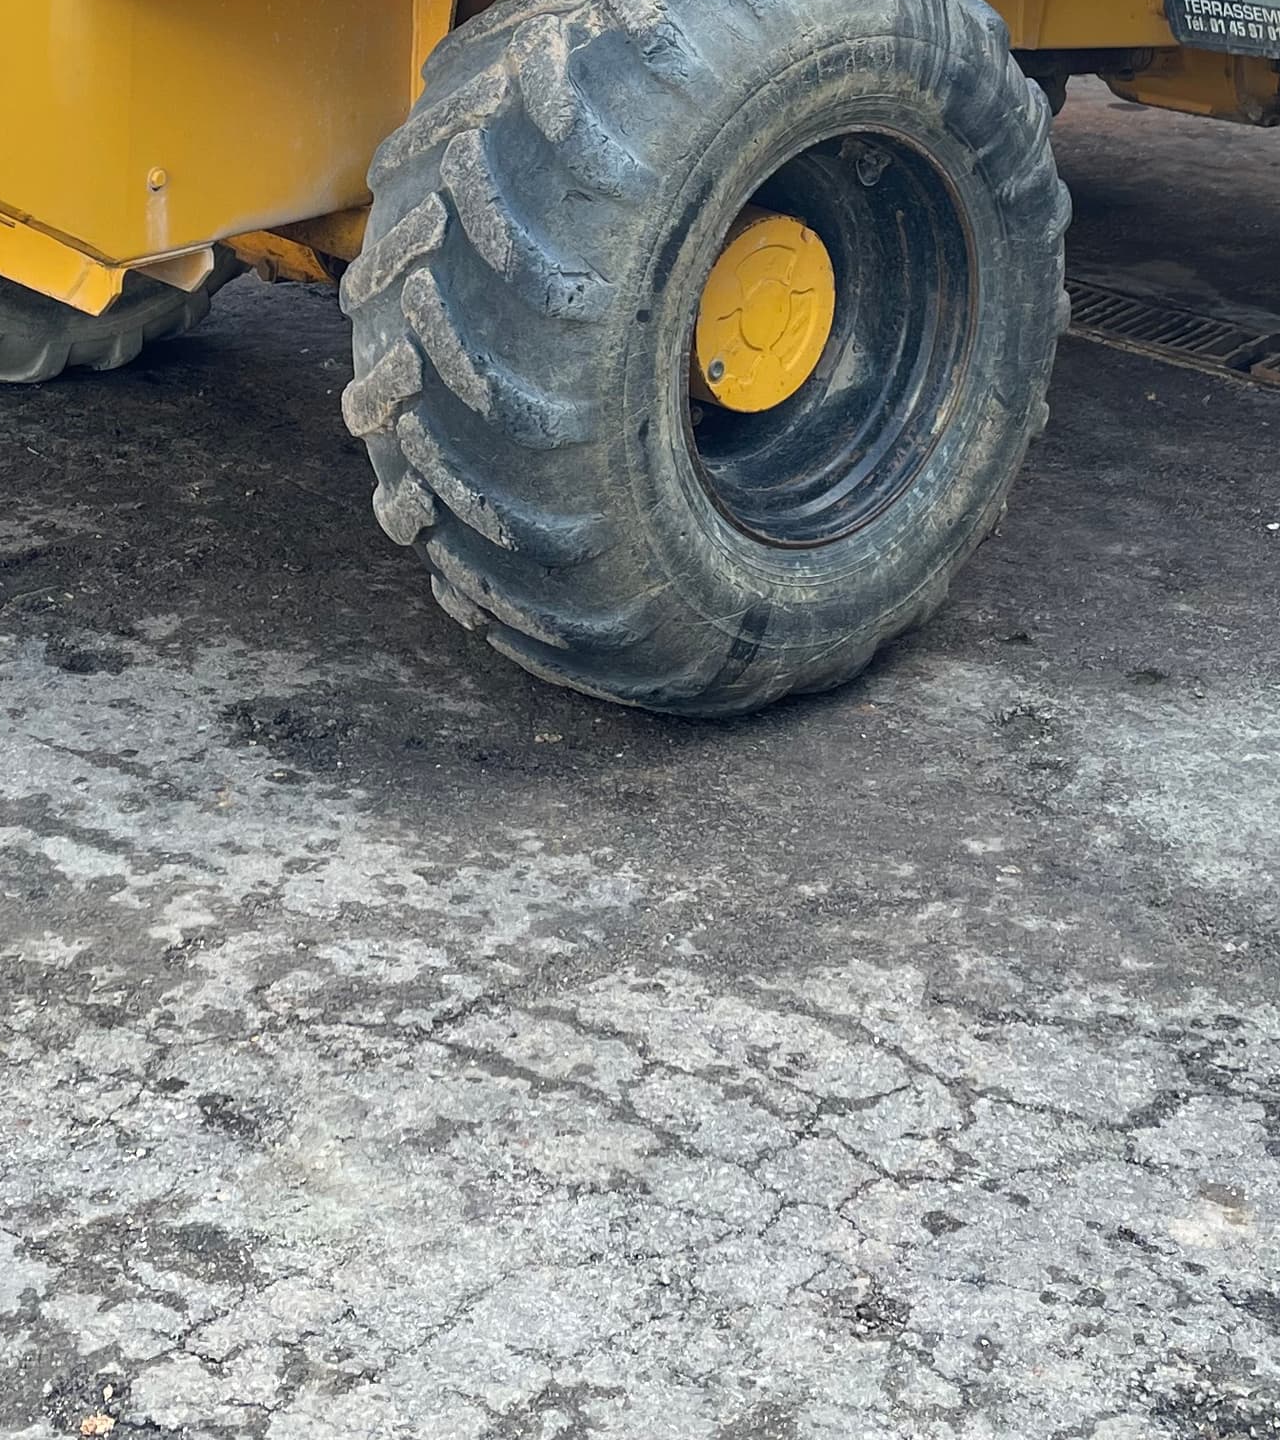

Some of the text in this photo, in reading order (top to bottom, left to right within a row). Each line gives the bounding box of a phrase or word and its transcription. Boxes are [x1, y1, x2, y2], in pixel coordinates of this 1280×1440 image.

[1184, 14, 1208, 32] Tél.
[1209, 18, 1226, 35] 01
[1229, 21, 1246, 37] 45
